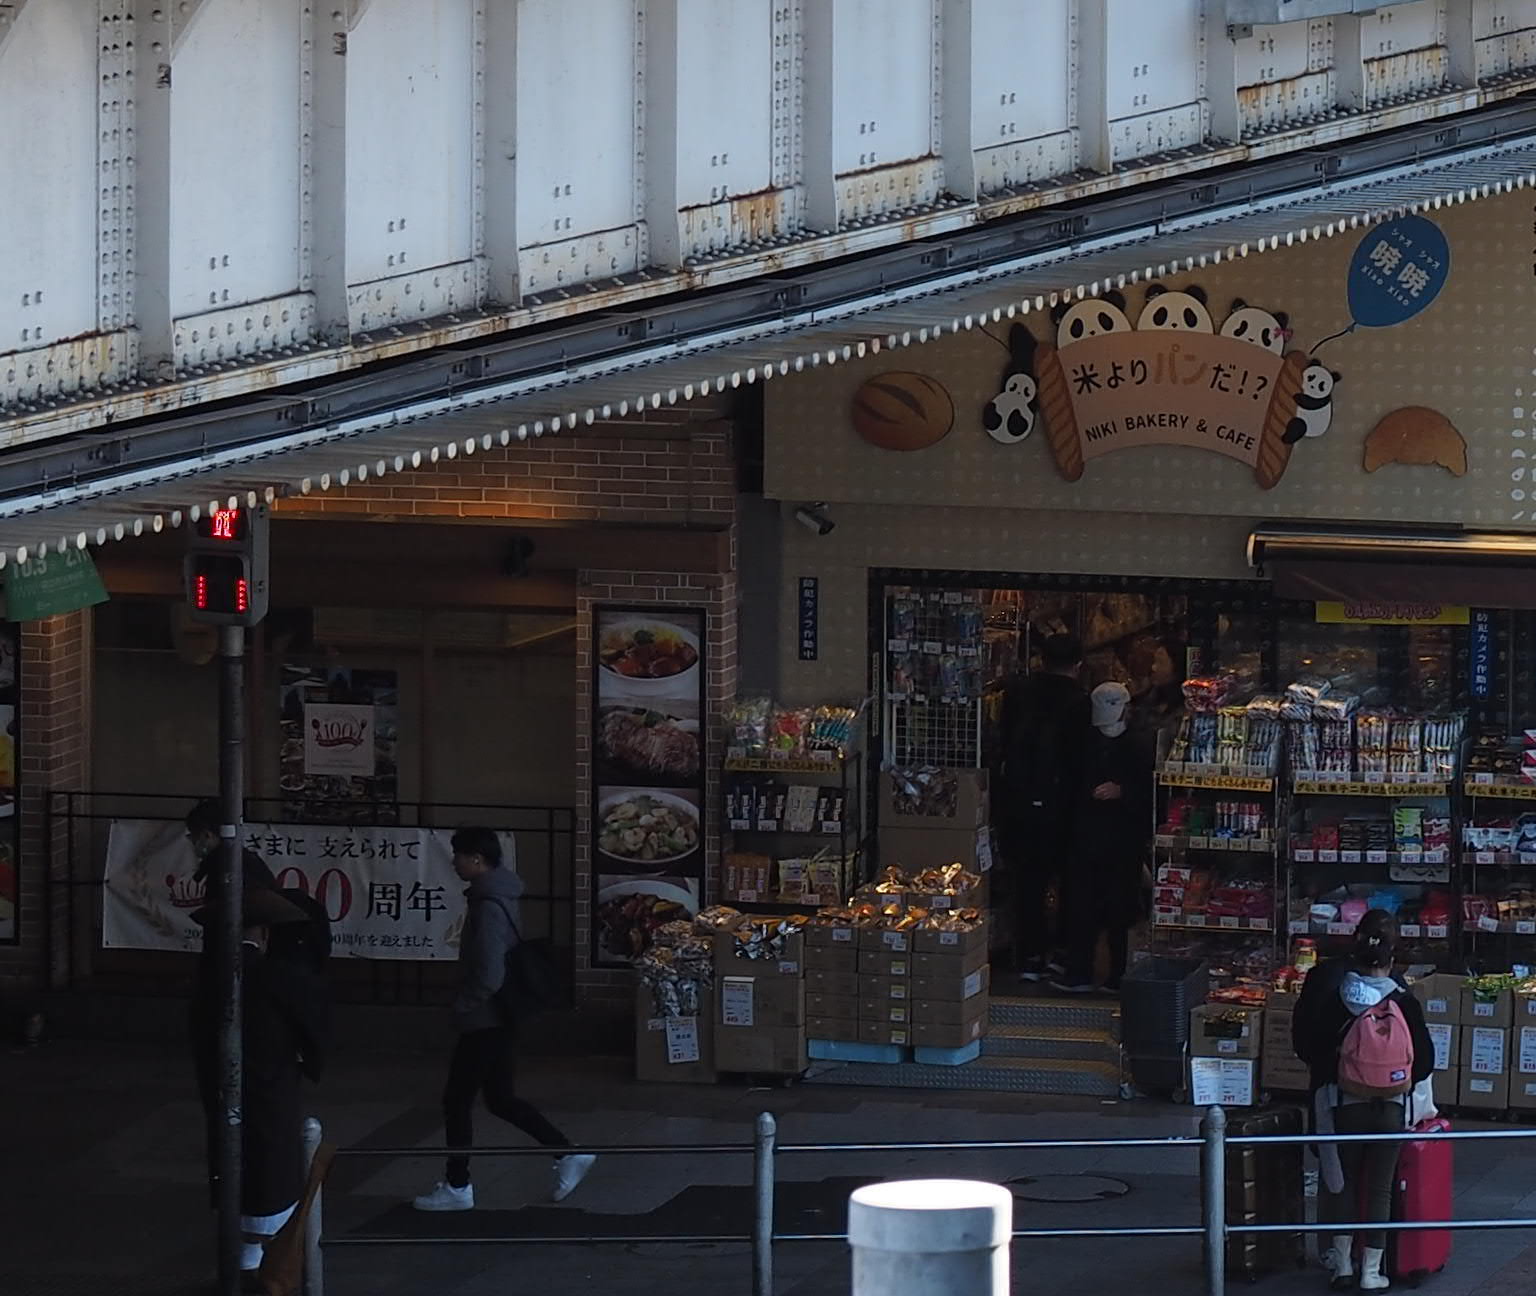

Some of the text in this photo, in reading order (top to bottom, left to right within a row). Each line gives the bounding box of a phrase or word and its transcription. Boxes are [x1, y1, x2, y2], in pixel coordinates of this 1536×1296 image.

[1084, 412, 1257, 452] NIKI BAKERY & CAFE
[367, 881, 447, 924] 周年
